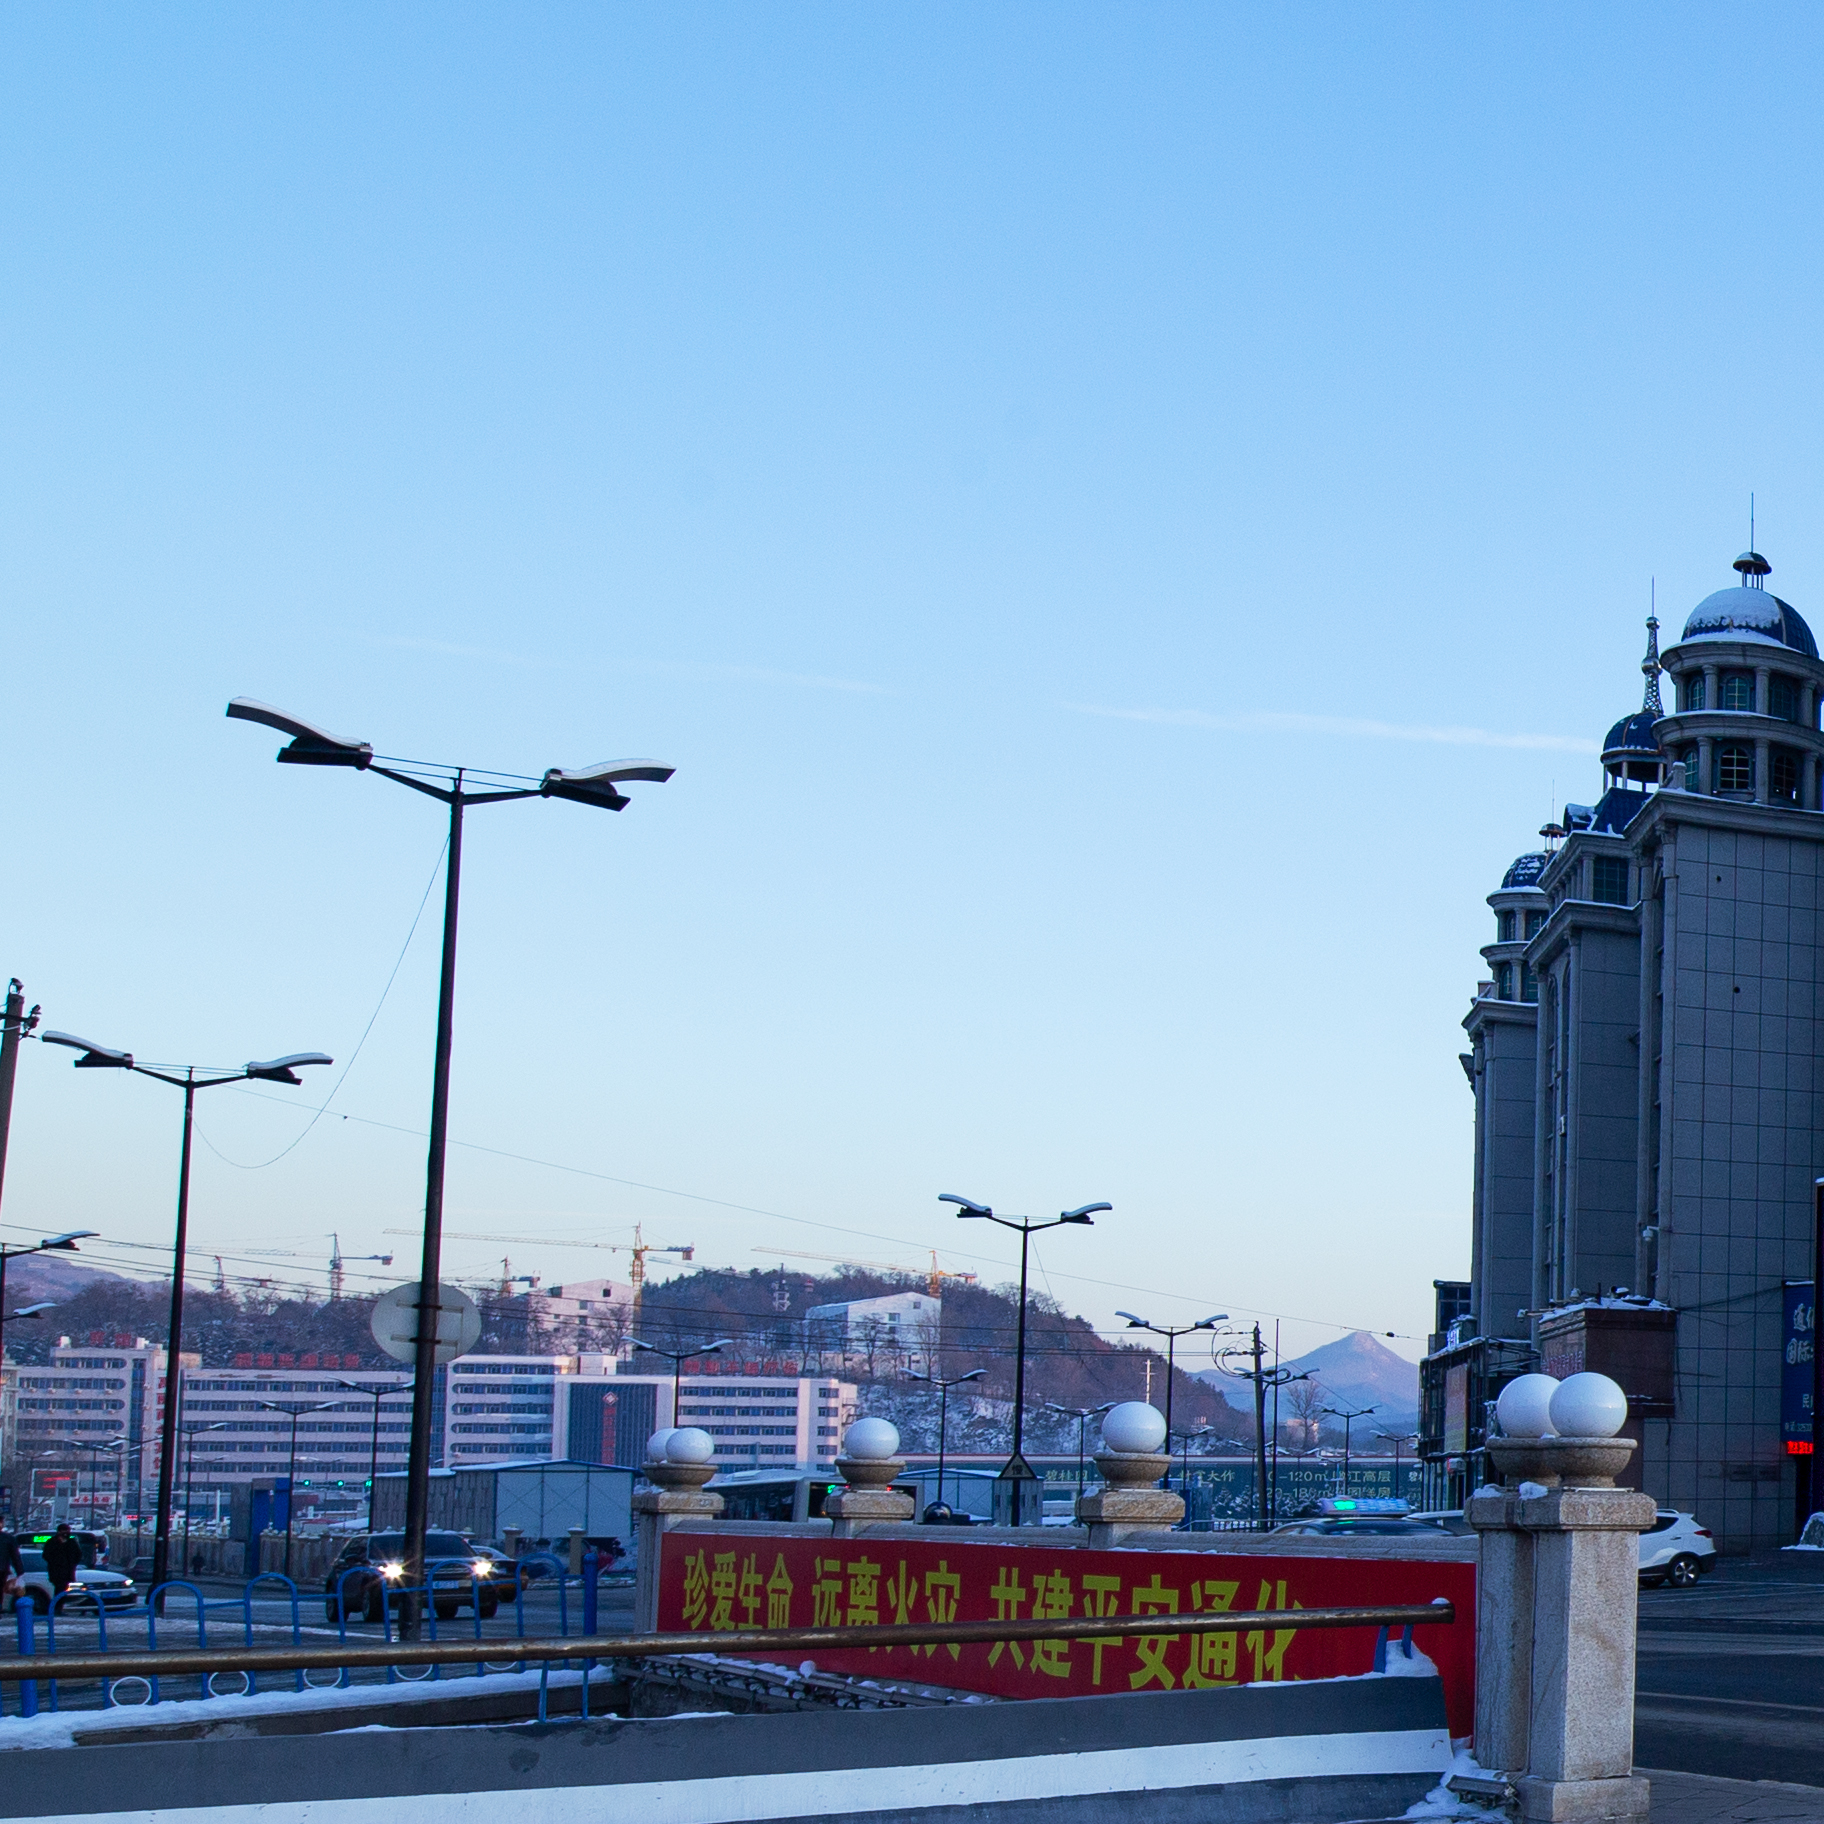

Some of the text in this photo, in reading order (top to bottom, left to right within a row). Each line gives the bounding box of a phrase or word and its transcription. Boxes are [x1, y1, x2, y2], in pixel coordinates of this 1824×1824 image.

[682, 1548, 1307, 1689] 珍爱生命 远离火灾 共建平安通化
